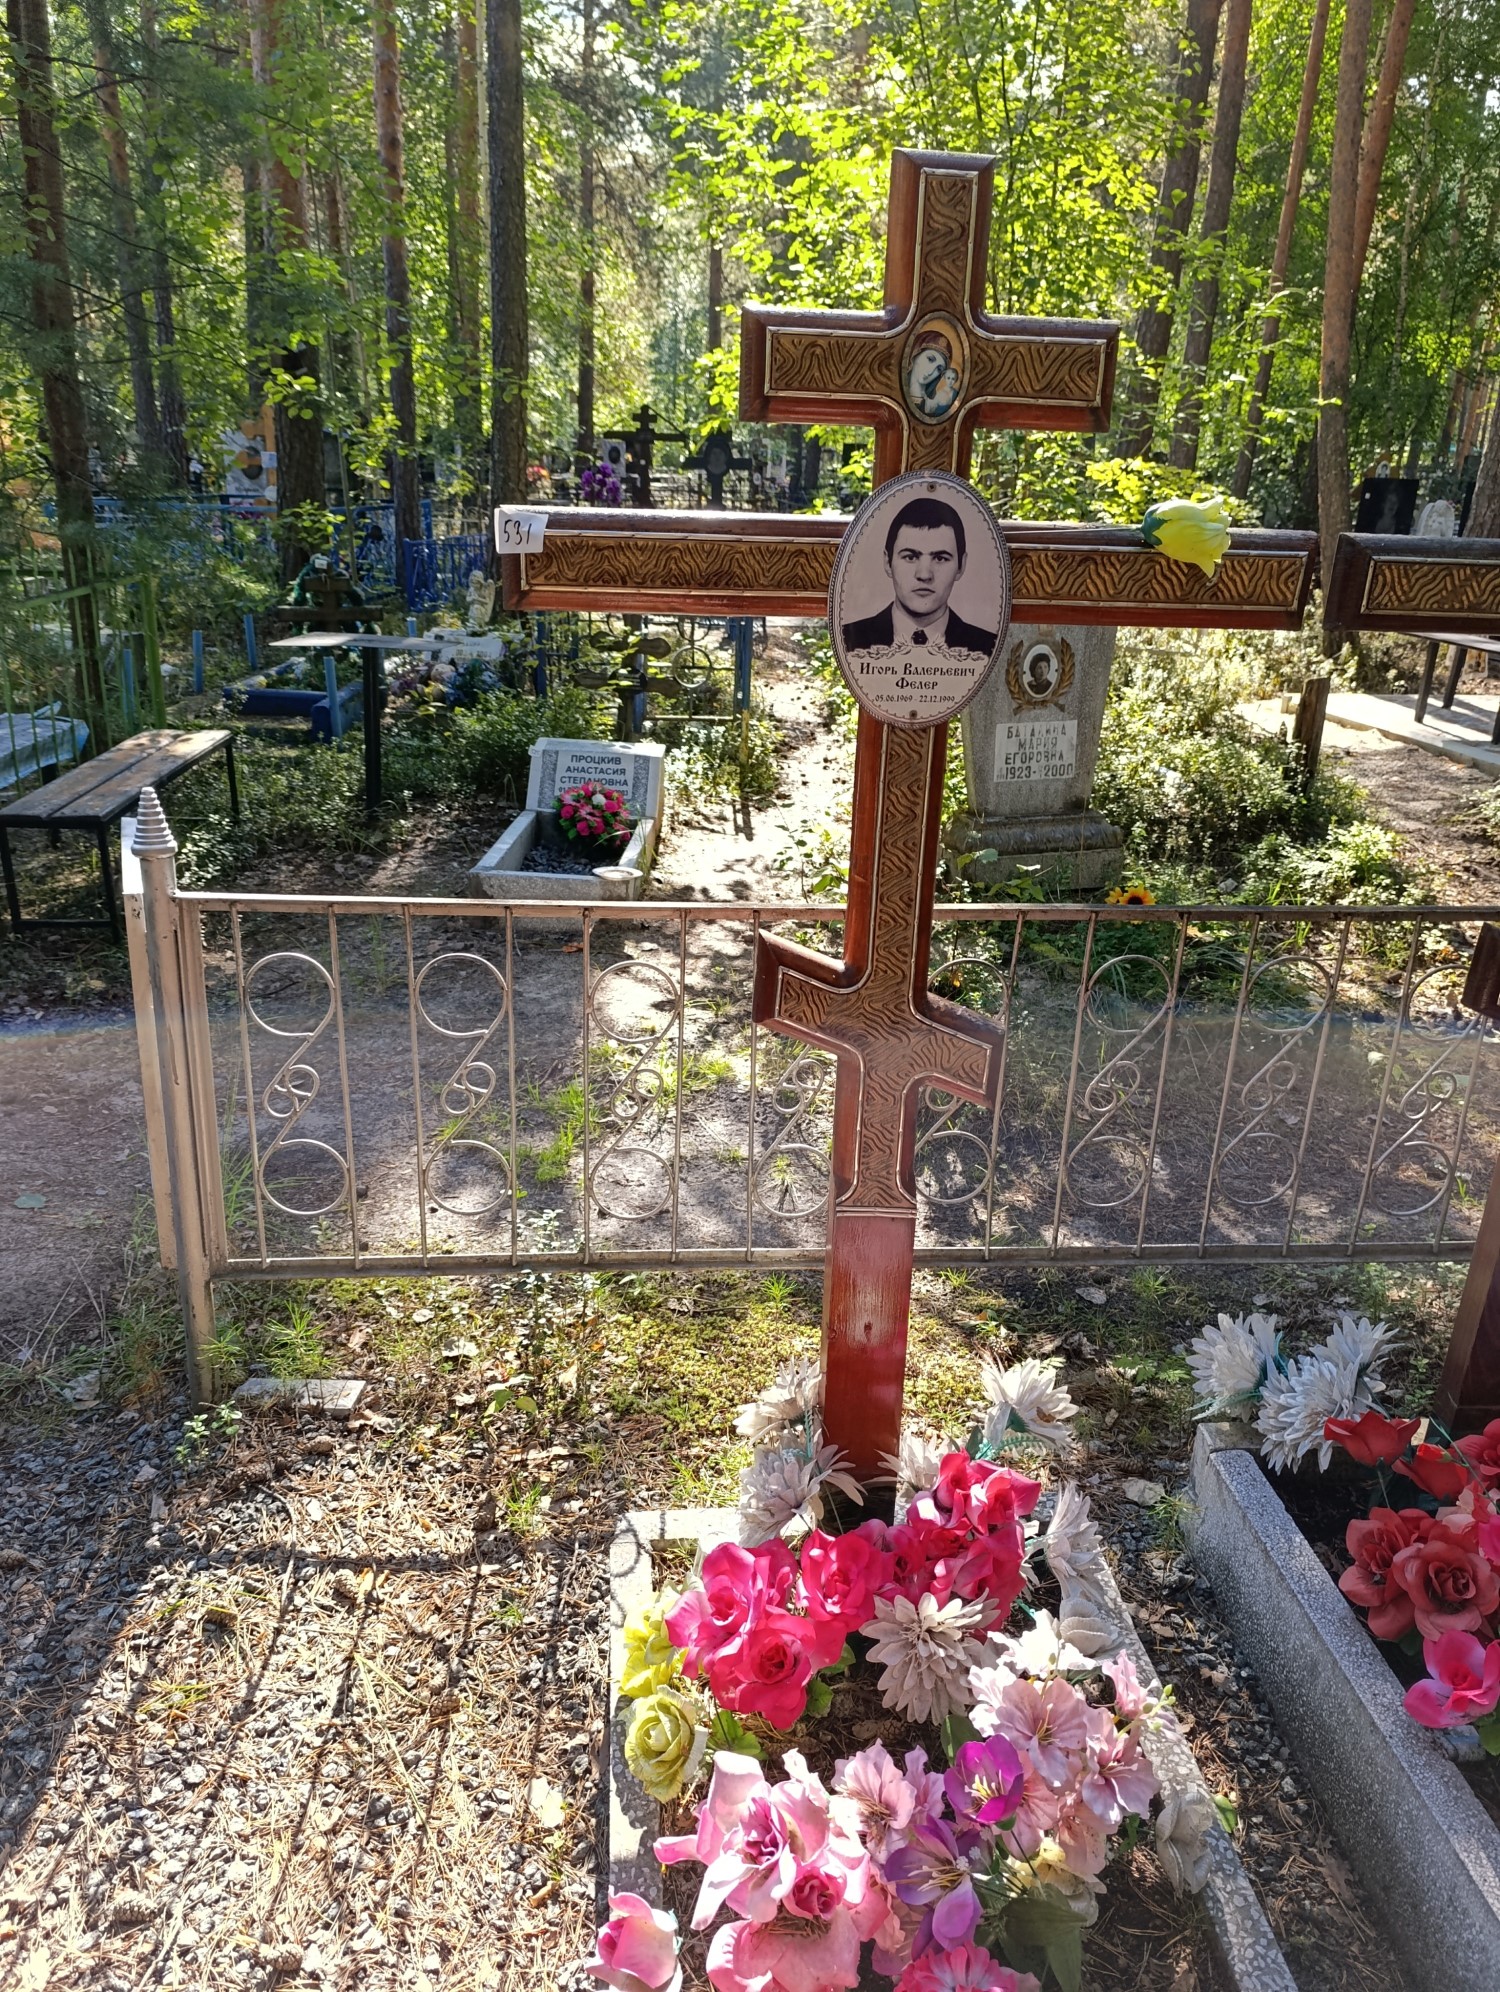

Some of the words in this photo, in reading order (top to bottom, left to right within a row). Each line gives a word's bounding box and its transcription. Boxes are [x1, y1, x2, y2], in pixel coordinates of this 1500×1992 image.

[503, 519, 533, 546] 531
[874, 694, 913, 703] 05.06.1969
[919, 694, 955, 704] 22.12.1999
[1018, 736, 1058, 751] МАРИЯ
[570, 754, 622, 765] ПРОЦКИВ
[1005, 750, 1064, 765] ЕГОРОВНА
[565, 766, 627, 776] АНАСТАСИЯ
[1044, 763, 1074, 778] 2000
